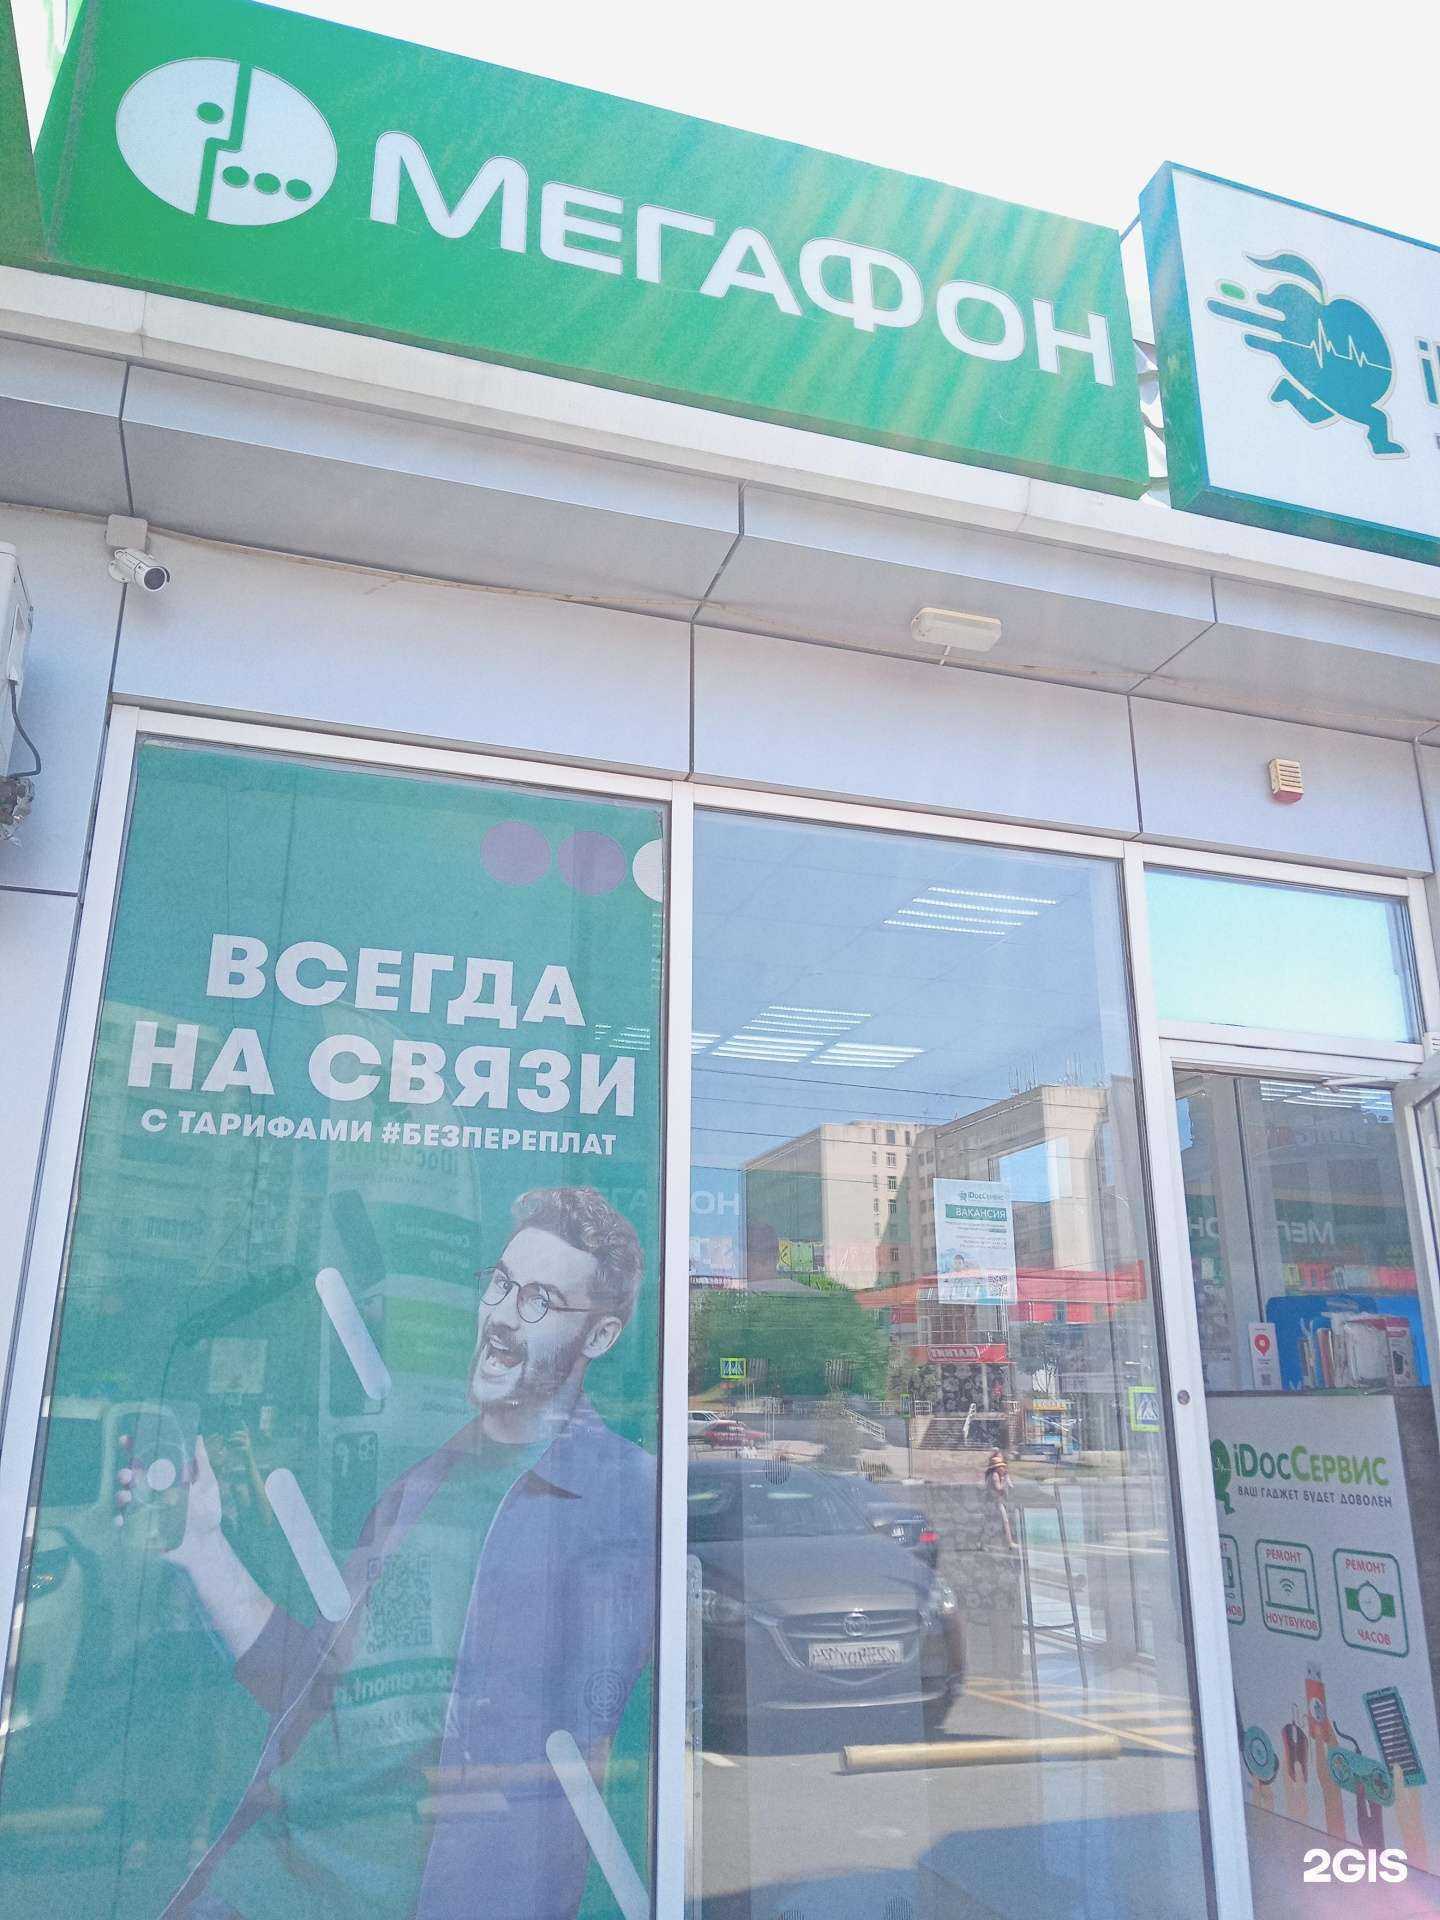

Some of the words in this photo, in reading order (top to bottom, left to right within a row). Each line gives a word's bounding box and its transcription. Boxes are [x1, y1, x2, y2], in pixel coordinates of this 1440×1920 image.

[369, 131, 1116, 387] МЕГАФОН
[206, 933, 586, 1029] ВСЕГДА
[127, 1020, 275, 1095] НА
[308, 1033, 637, 1117] СВЯЗИ
[140, 1108, 168, 1132] С
[178, 1110, 372, 1143] ТАРИФАМИ
[381, 1122, 617, 1155] #БЕЗПЕРЕПЛАТ
[955, 1207, 1006, 1219] ВАКАНСИЯ
[1238, 1485, 1258, 1497] ВАШ
[1261, 1487, 1299, 1501] ГАДЖЕТ
[1303, 1490, 1336, 1503] БУДЕТ
[1340, 1493, 1393, 1508] ДОВОЛЕН
[1265, 1548, 1303, 1564] РЕМОНТ
[1344, 1558, 1386, 1574] РЕМОНТ
[1265, 1611, 1319, 1632] НОУТБУКОВ
[1357, 1628, 1392, 1647] ЧАСОВ
